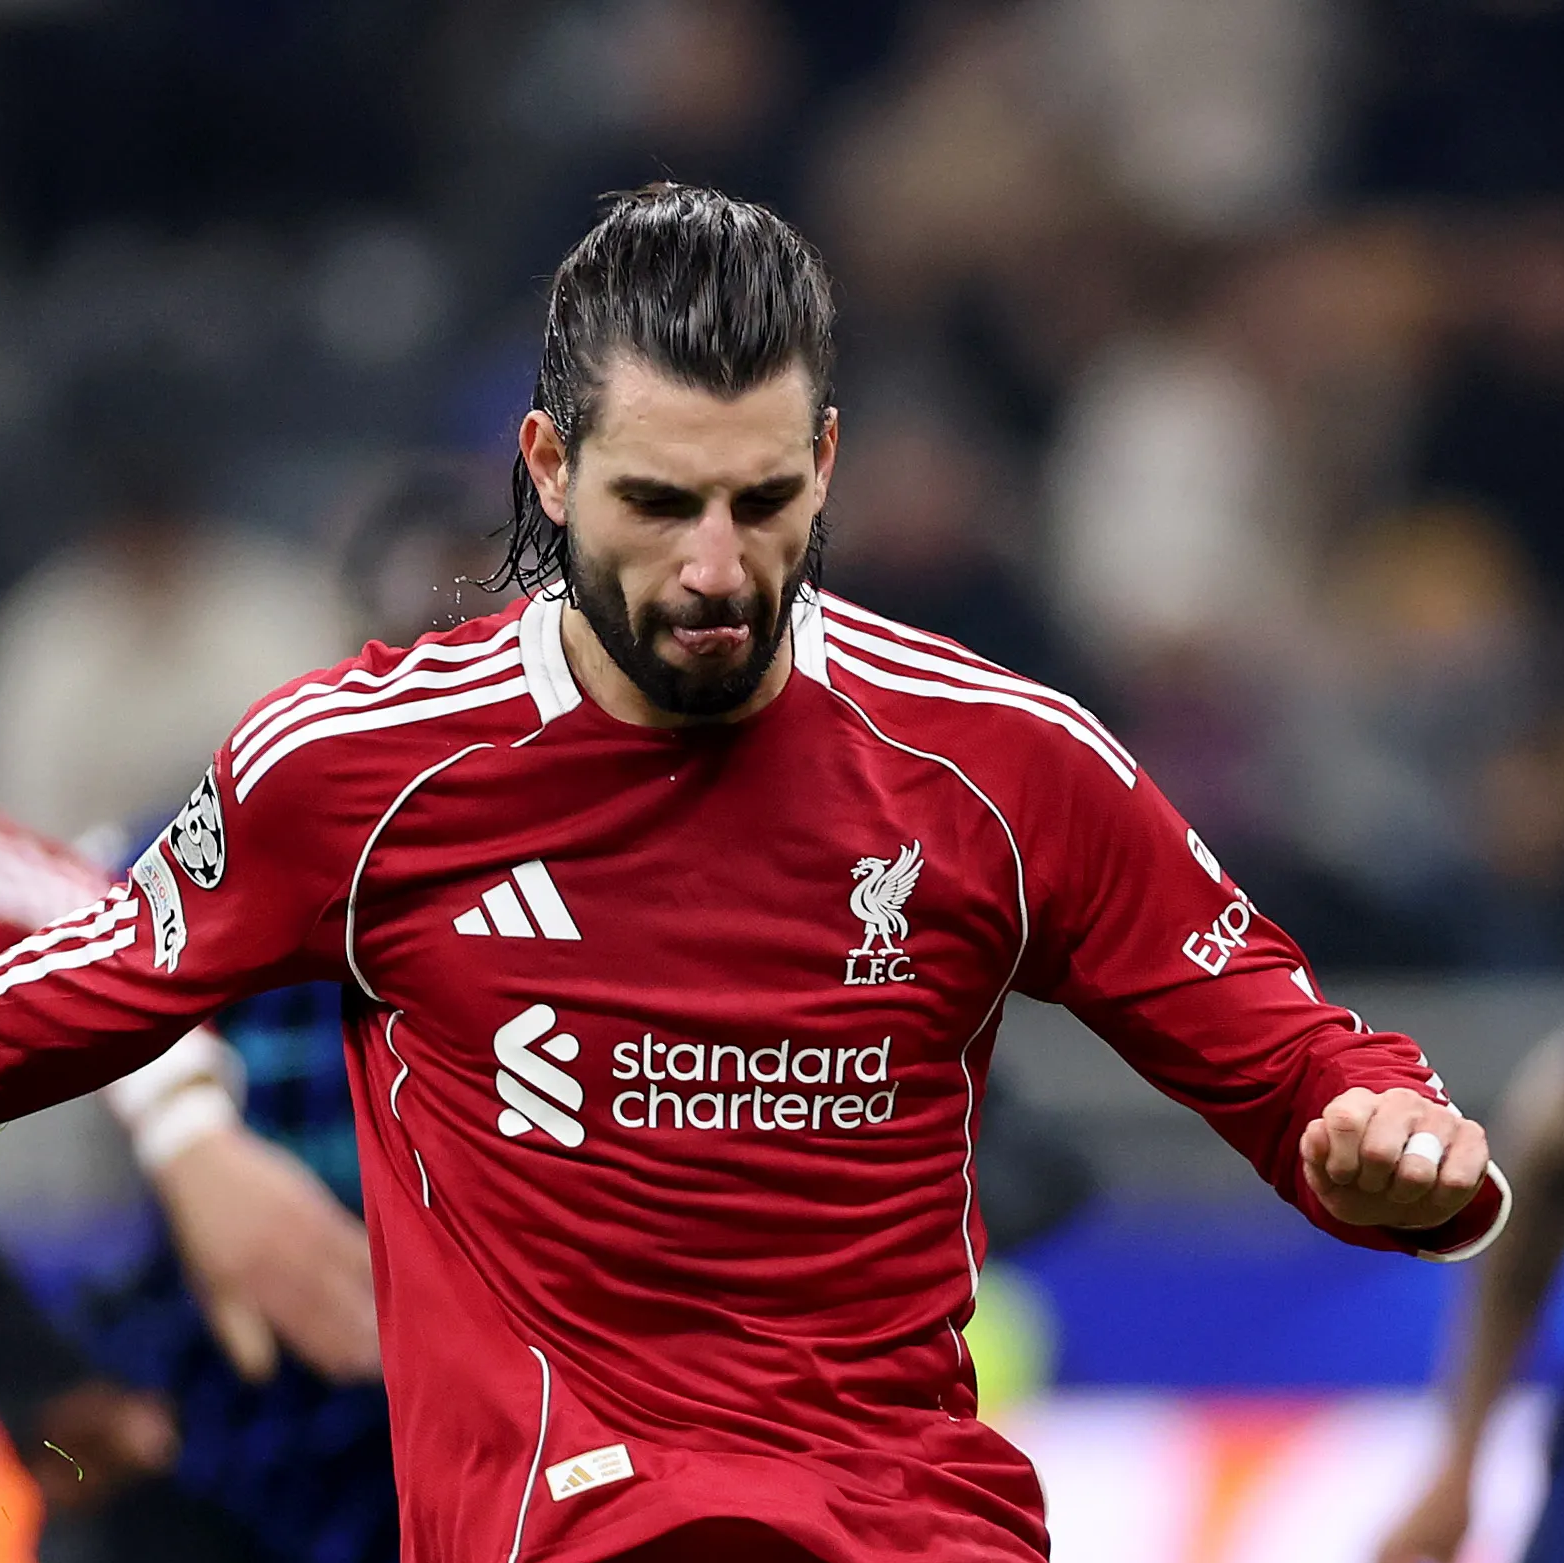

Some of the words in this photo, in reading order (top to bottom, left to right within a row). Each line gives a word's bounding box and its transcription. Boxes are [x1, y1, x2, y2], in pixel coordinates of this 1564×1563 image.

[843, 956, 916, 985] L.F.C.
[611, 1032, 891, 1084] standard
[611, 1080, 900, 1131] chartered
